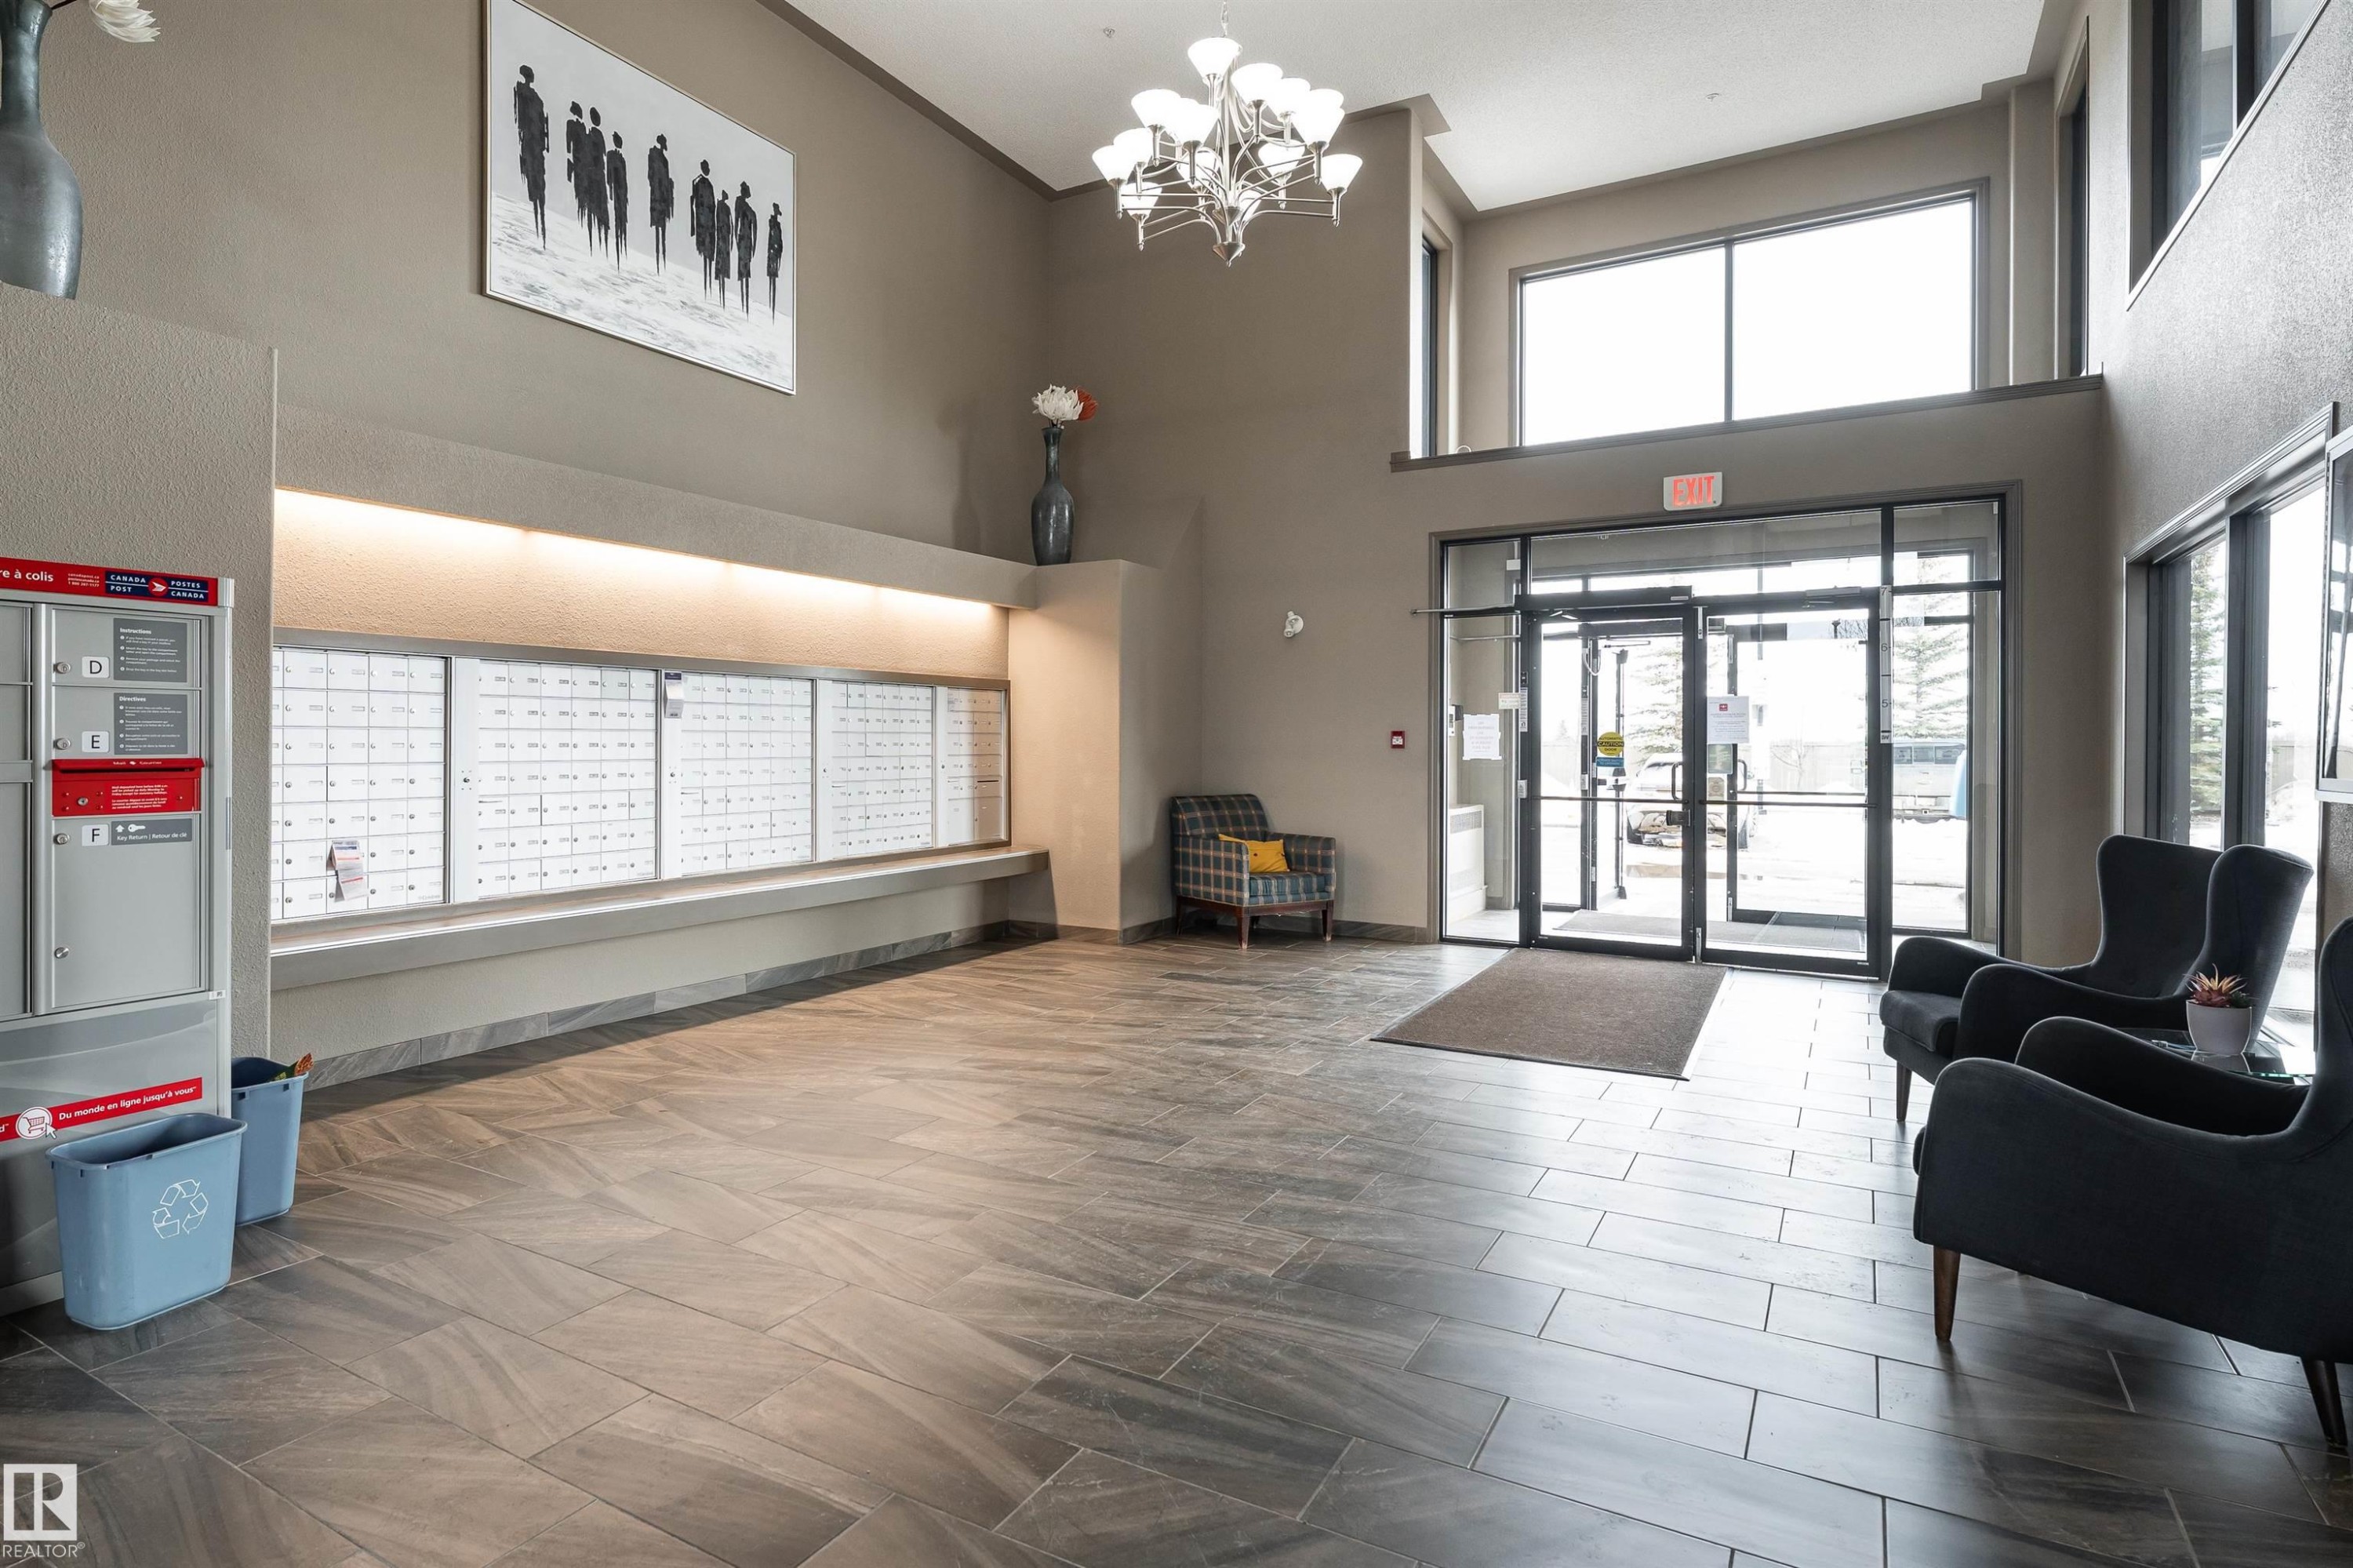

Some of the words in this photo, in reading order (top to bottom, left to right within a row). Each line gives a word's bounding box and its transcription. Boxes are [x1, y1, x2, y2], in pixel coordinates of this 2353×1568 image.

[1673, 475, 1715, 506] EXIT
[14, 569, 22, 579] à
[26, 571, 54, 582] colis
[111, 574, 147, 584] CANADA
[171, 591, 205, 599] CANADA
[89, 660, 103, 675] D
[91, 735, 100, 748] E
[92, 828, 100, 842] F
[59, 1112, 72, 1121] Du
[75, 1104, 105, 1117] monde
[120, 1097, 141, 1108] ligne
[143, 1090, 173, 1105] jusqu'à
